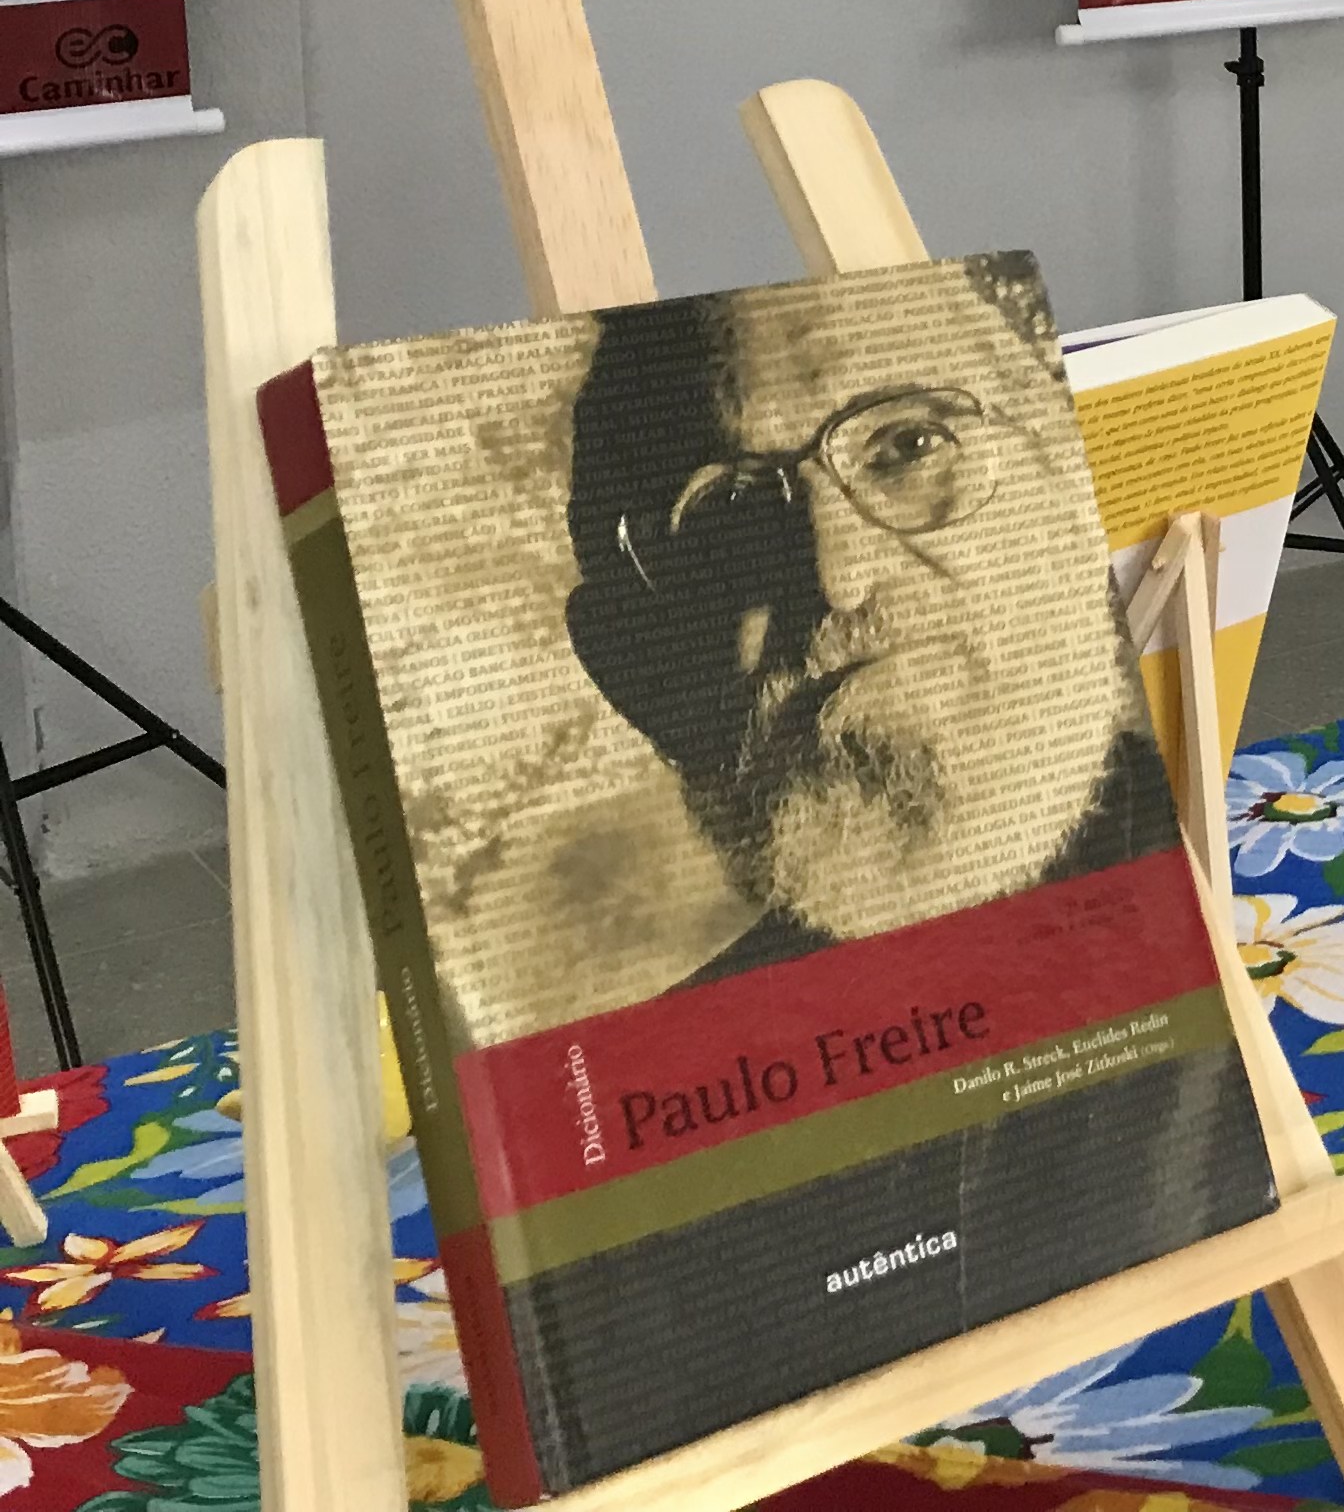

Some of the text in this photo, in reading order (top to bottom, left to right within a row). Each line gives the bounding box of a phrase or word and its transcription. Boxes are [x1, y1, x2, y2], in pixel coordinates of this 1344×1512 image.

[19, 67, 181, 103] Caminhar
[620, 1000, 991, 1152] Paulo Freire
[953, 1066, 1001, 1095] Danilo
[1003, 1060, 1020, 1077] R.
[1072, 1027, 1128, 1055] Euclides
[1130, 1013, 1169, 1036] Redin
[1002, 1091, 1012, 1102] e
[1014, 1075, 1053, 1102] Jaime
[1055, 1061, 1084, 1088] José
[567, 1044, 606, 1167] Dicionário
[825, 1226, 957, 1294] autêntica
